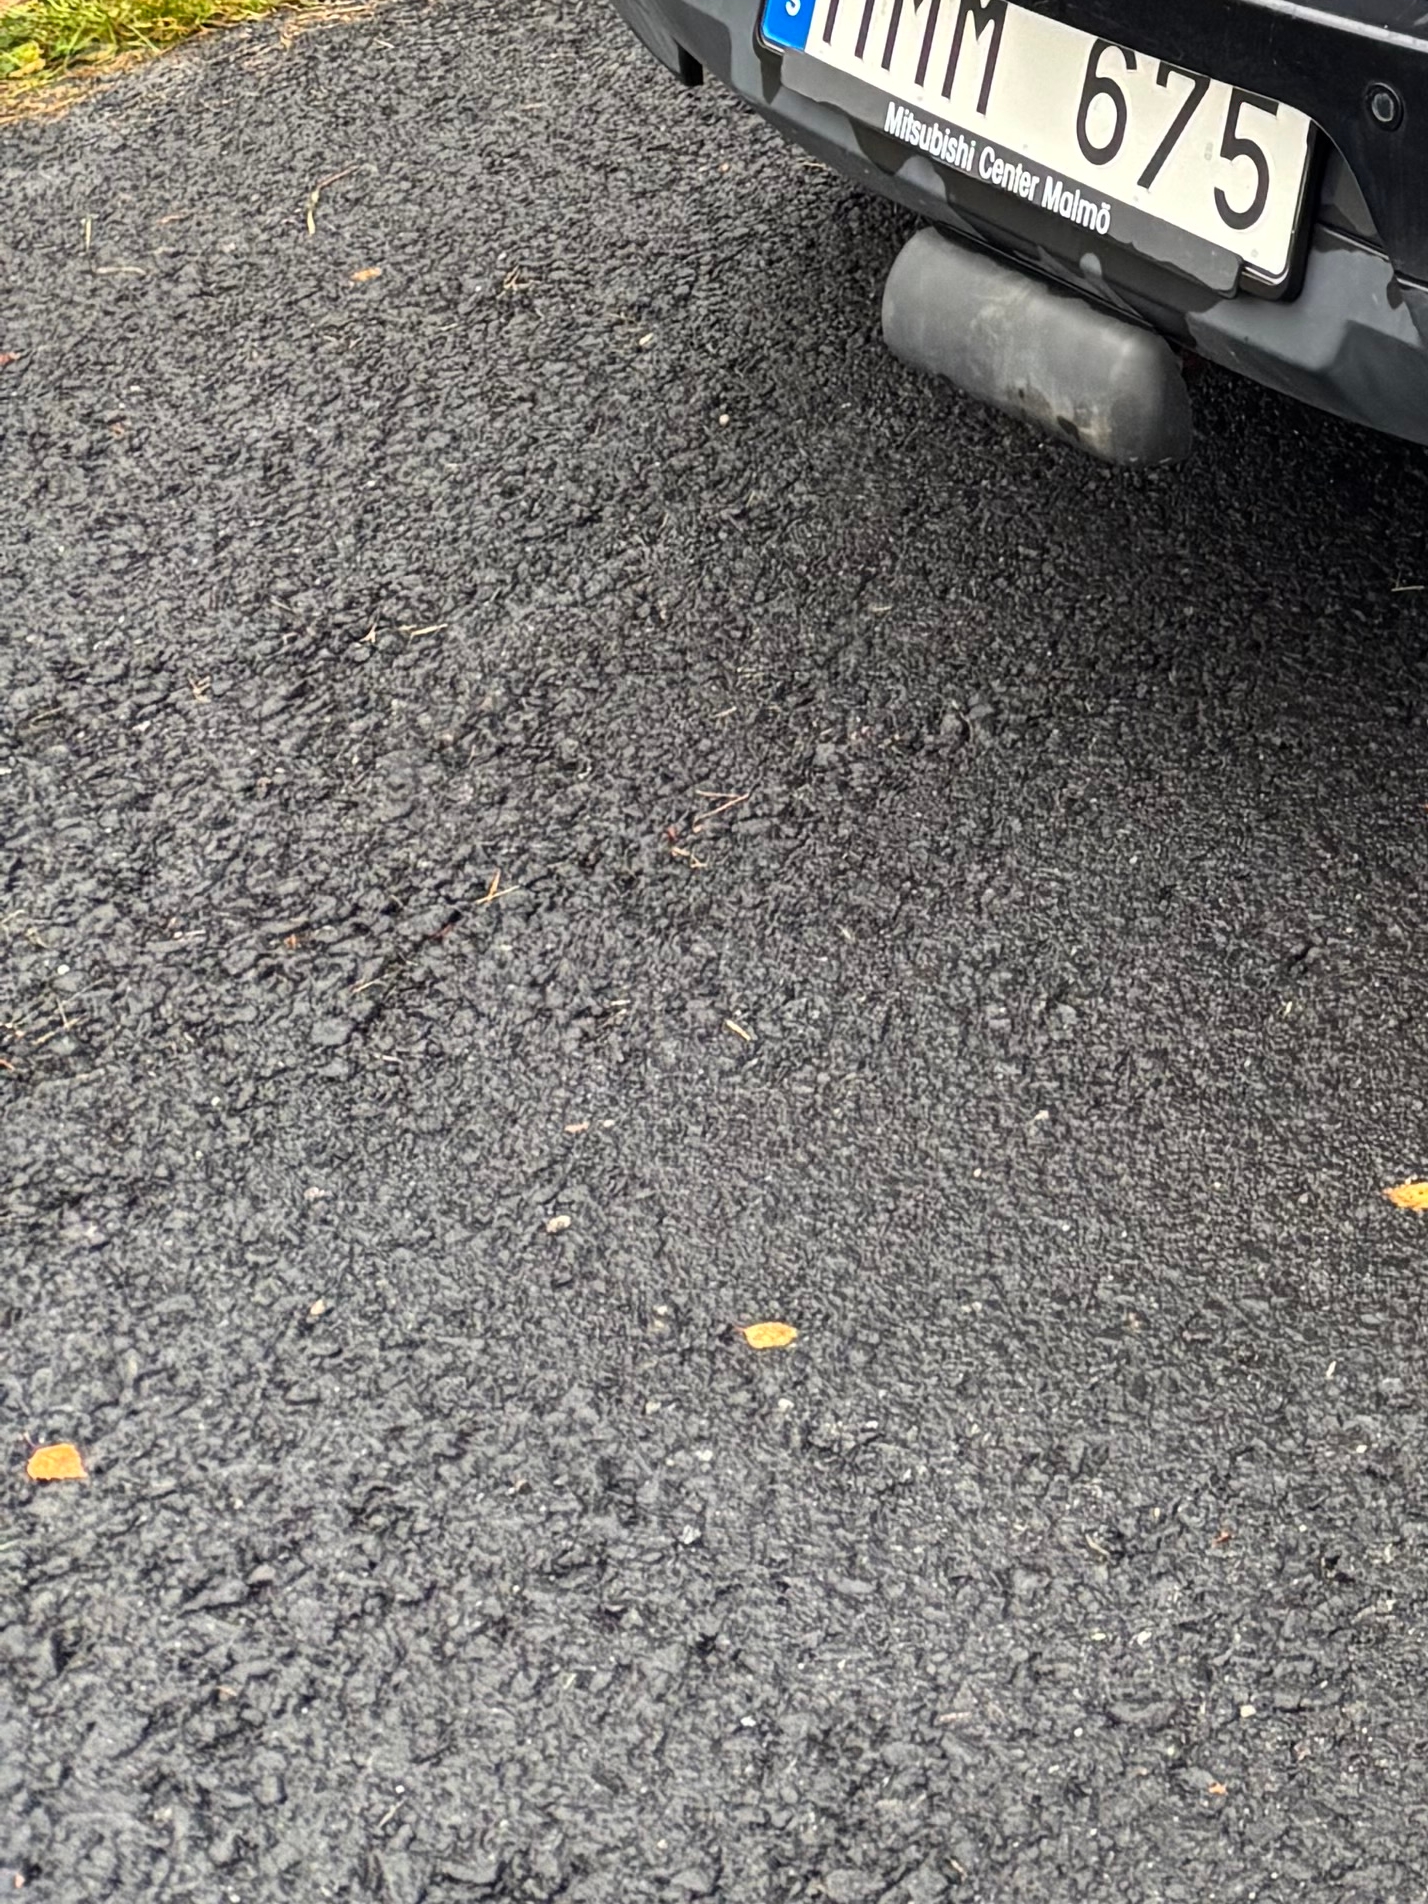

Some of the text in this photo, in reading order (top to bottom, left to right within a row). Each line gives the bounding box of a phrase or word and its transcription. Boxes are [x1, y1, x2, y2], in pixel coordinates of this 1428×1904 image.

[884, 101, 1111, 234] Mitsubishi Center Malmö
[1076, 37, 1280, 230] 675
